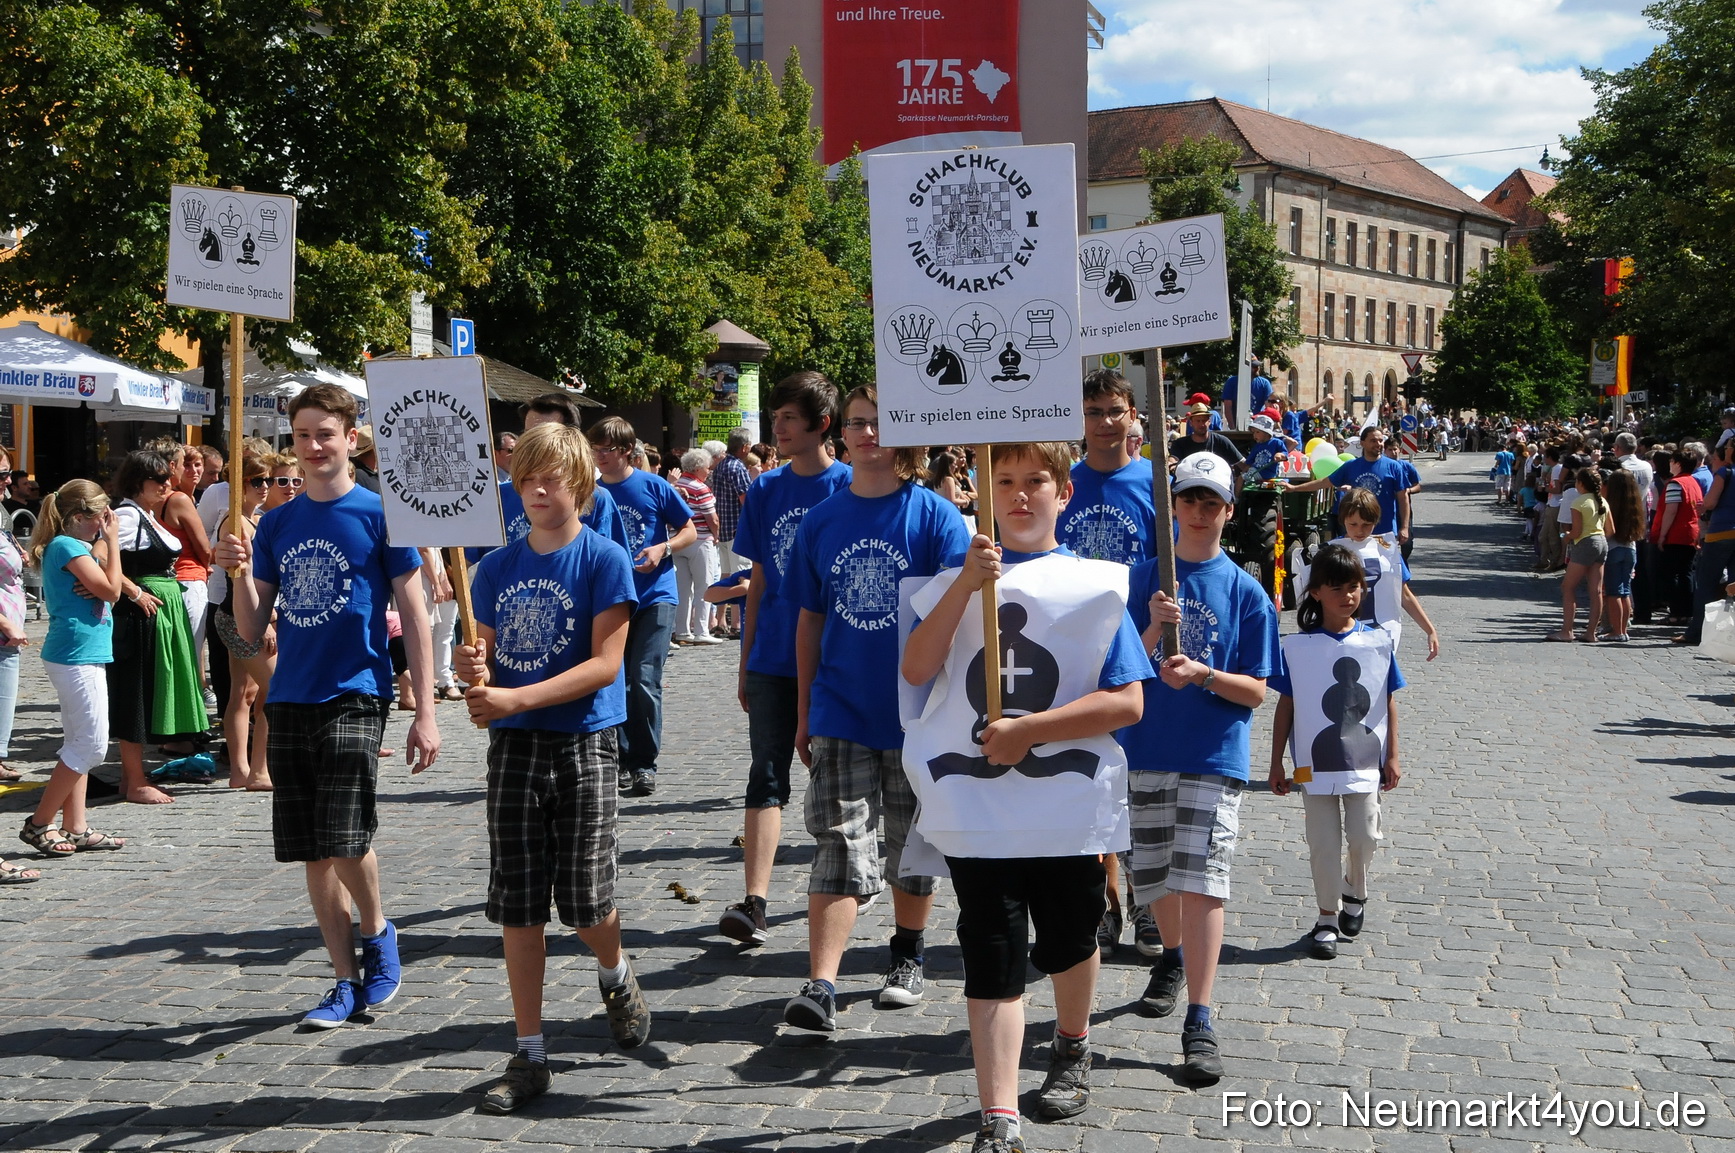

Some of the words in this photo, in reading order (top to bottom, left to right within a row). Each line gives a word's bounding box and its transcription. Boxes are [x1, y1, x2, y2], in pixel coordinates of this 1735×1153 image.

[836, 7, 864, 21] und
[868, 7, 897, 20] Ihre
[899, 6, 945, 20] Treue.
[896, 59, 964, 87] 175
[897, 88, 964, 105] JAHRE
[897, 114, 936, 123] Sparkasse
[937, 113, 1010, 123] Neumarkt-Parsberg
[909, 153, 1033, 207] SCHACHKLUB
[907, 240, 1014, 293] NEUMARKT
[1013, 236, 1038, 268] E.V.
[174, 274, 191, 287] Wir
[193, 278, 224, 292] spielen
[226, 282, 245, 295] eine
[247, 284, 284, 300] Sprache
[1101, 321, 1141, 337] spielen
[1144, 317, 1169, 329] eine
[1171, 310, 1219, 328] Sprache
[456, 325, 469, 356] P
[0, 368, 39, 387] inkler
[42, 371, 77, 389] Bräu
[252, 394, 276, 409] Bräu
[1629, 391, 1644, 402] WC
[379, 389, 481, 439] SCHACHKLUB
[888, 409, 916, 424] Wir
[920, 407, 972, 426] spielen
[976, 406, 1008, 420] eine
[1011, 404, 1072, 423] Sprache
[382, 468, 474, 518] NEUMARKT
[471, 468, 490, 496] E.V.
[617, 504, 643, 521] HKLUB
[771, 507, 809, 537] SCHACH
[1064, 504, 1138, 535] SCHACHKLUB
[279, 538, 351, 574] SCHACHKLUB
[831, 538, 909, 575] SCHACHKLUB
[495, 578, 574, 612] SCHACHKLUB
[1177, 597, 1219, 627] CHKLUB
[495, 648, 550, 673] UMARKT
